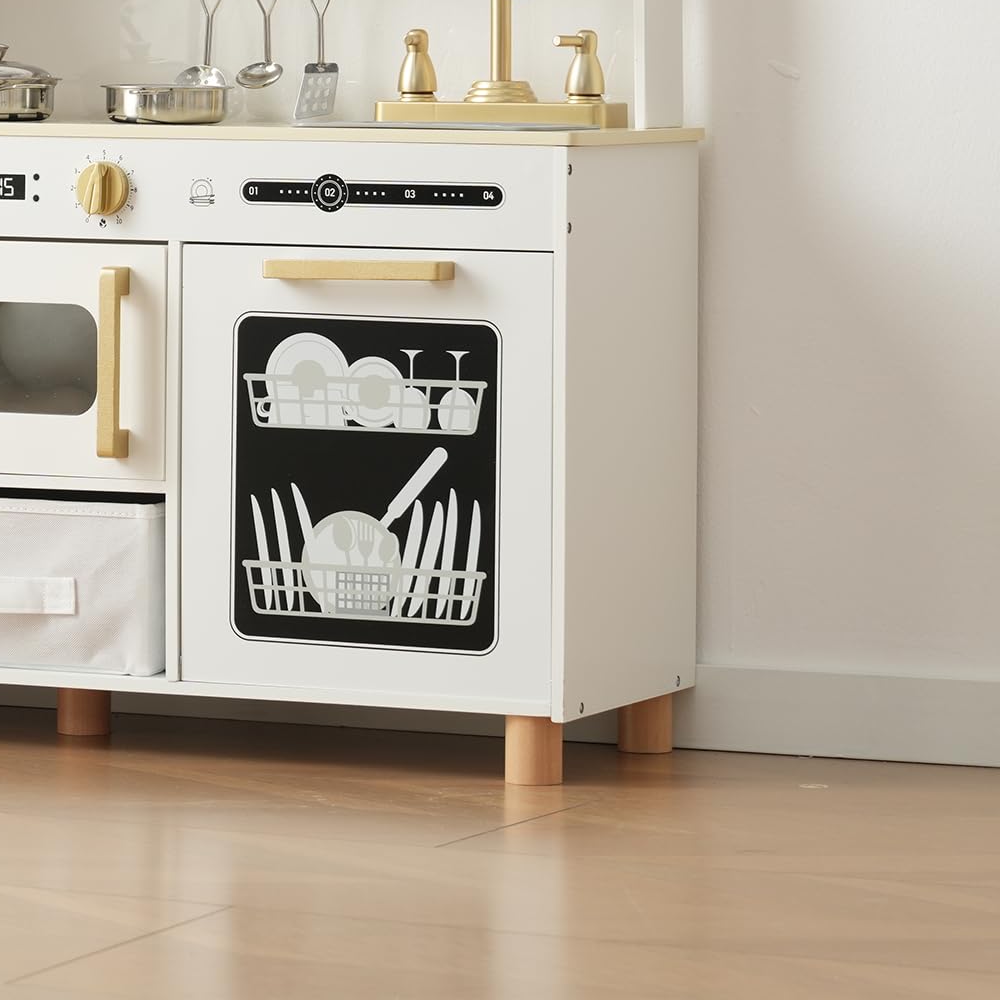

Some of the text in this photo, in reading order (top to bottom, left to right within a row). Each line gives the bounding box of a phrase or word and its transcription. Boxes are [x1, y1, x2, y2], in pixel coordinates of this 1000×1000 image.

[248, 186, 495, 201] 01 02 03 04
